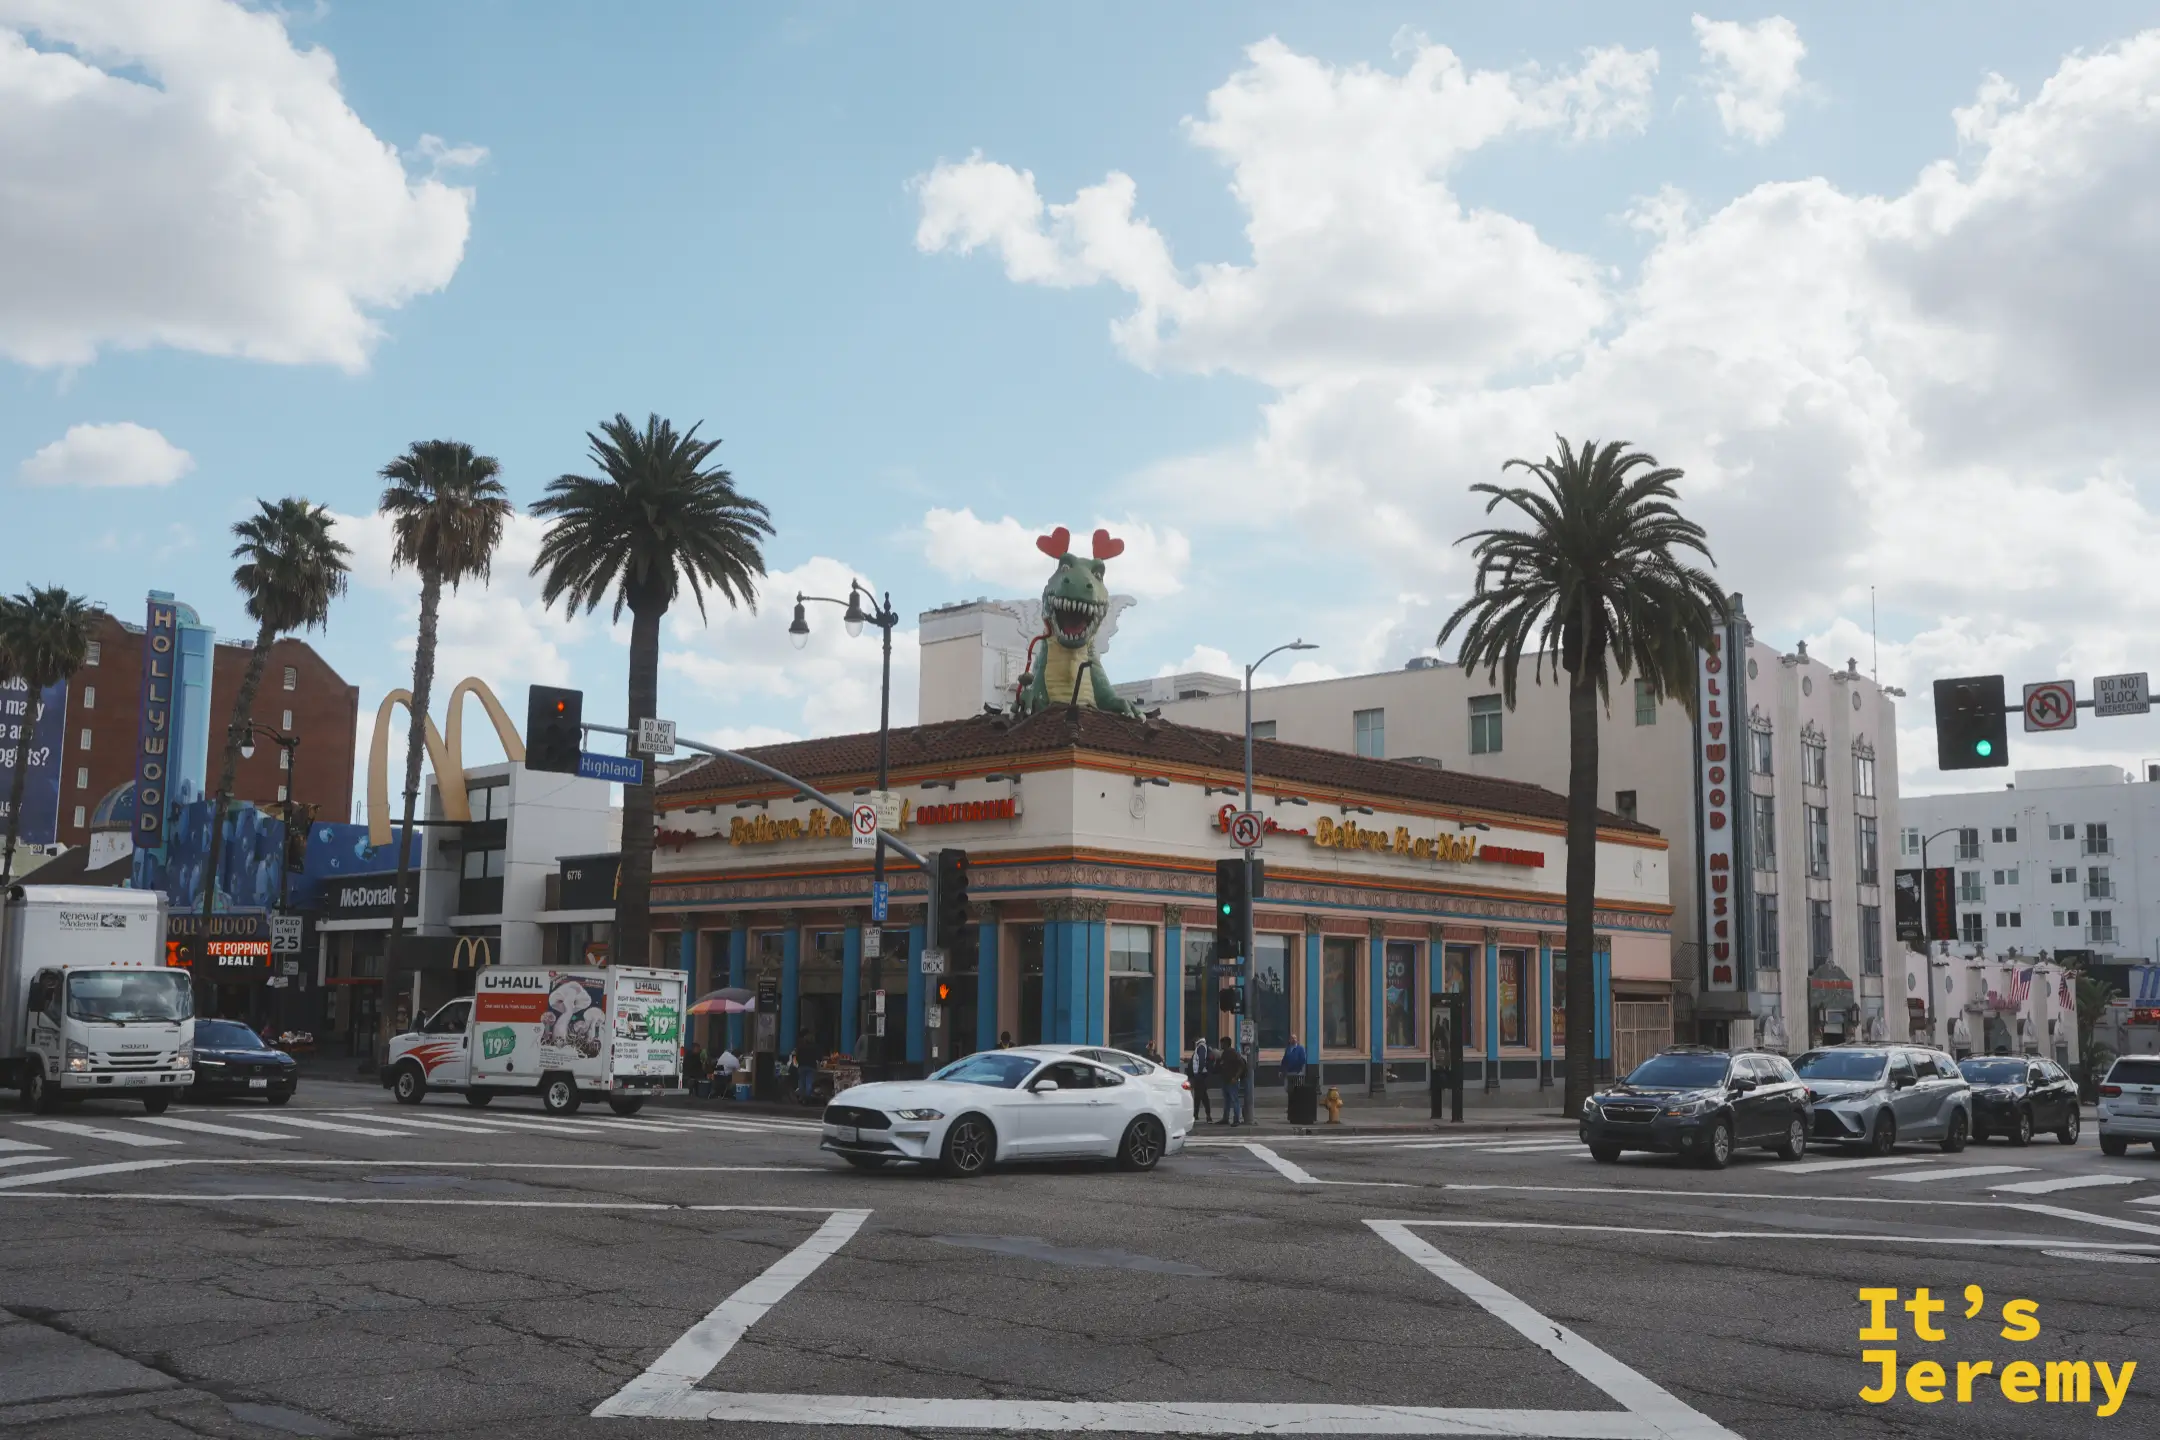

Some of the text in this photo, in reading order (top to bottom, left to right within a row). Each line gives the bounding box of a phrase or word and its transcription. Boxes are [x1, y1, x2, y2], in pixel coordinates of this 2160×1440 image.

[2100, 677, 2140, 691] DO NOT
[2104, 690, 2139, 704] BLOCK
[5, 699, 46, 722] may
[2097, 702, 2147, 714] INTERSECTION
[140, 608, 172, 832] HOLLYWOOD
[644, 720, 671, 734] DO NOT
[645, 732, 669, 745] BLOCK
[639, 742, 674, 753] INTERSECTION
[581, 757, 636, 778] Highland
[729, 813, 802, 847] Believe
[916, 798, 1016, 826] ODDITORIUM
[854, 837, 863, 845] ON
[1314, 816, 1389, 852] Believe
[1392, 826, 1411, 856] It
[1437, 832, 1476, 864] Not!
[567, 871, 582, 881] 6776
[60, 911, 99, 921] Renewal
[1709, 853, 1733, 984] MUSEUM
[65, 919, 99, 928] Andersen
[167, 917, 258, 936] OLLWOOD
[223, 942, 268, 956] POPPING
[273, 936, 299, 950] 25
[218, 955, 254, 966] DEAL!
[484, 976, 544, 989] U-HAUL
[635, 982, 662, 991] U-HAUL
